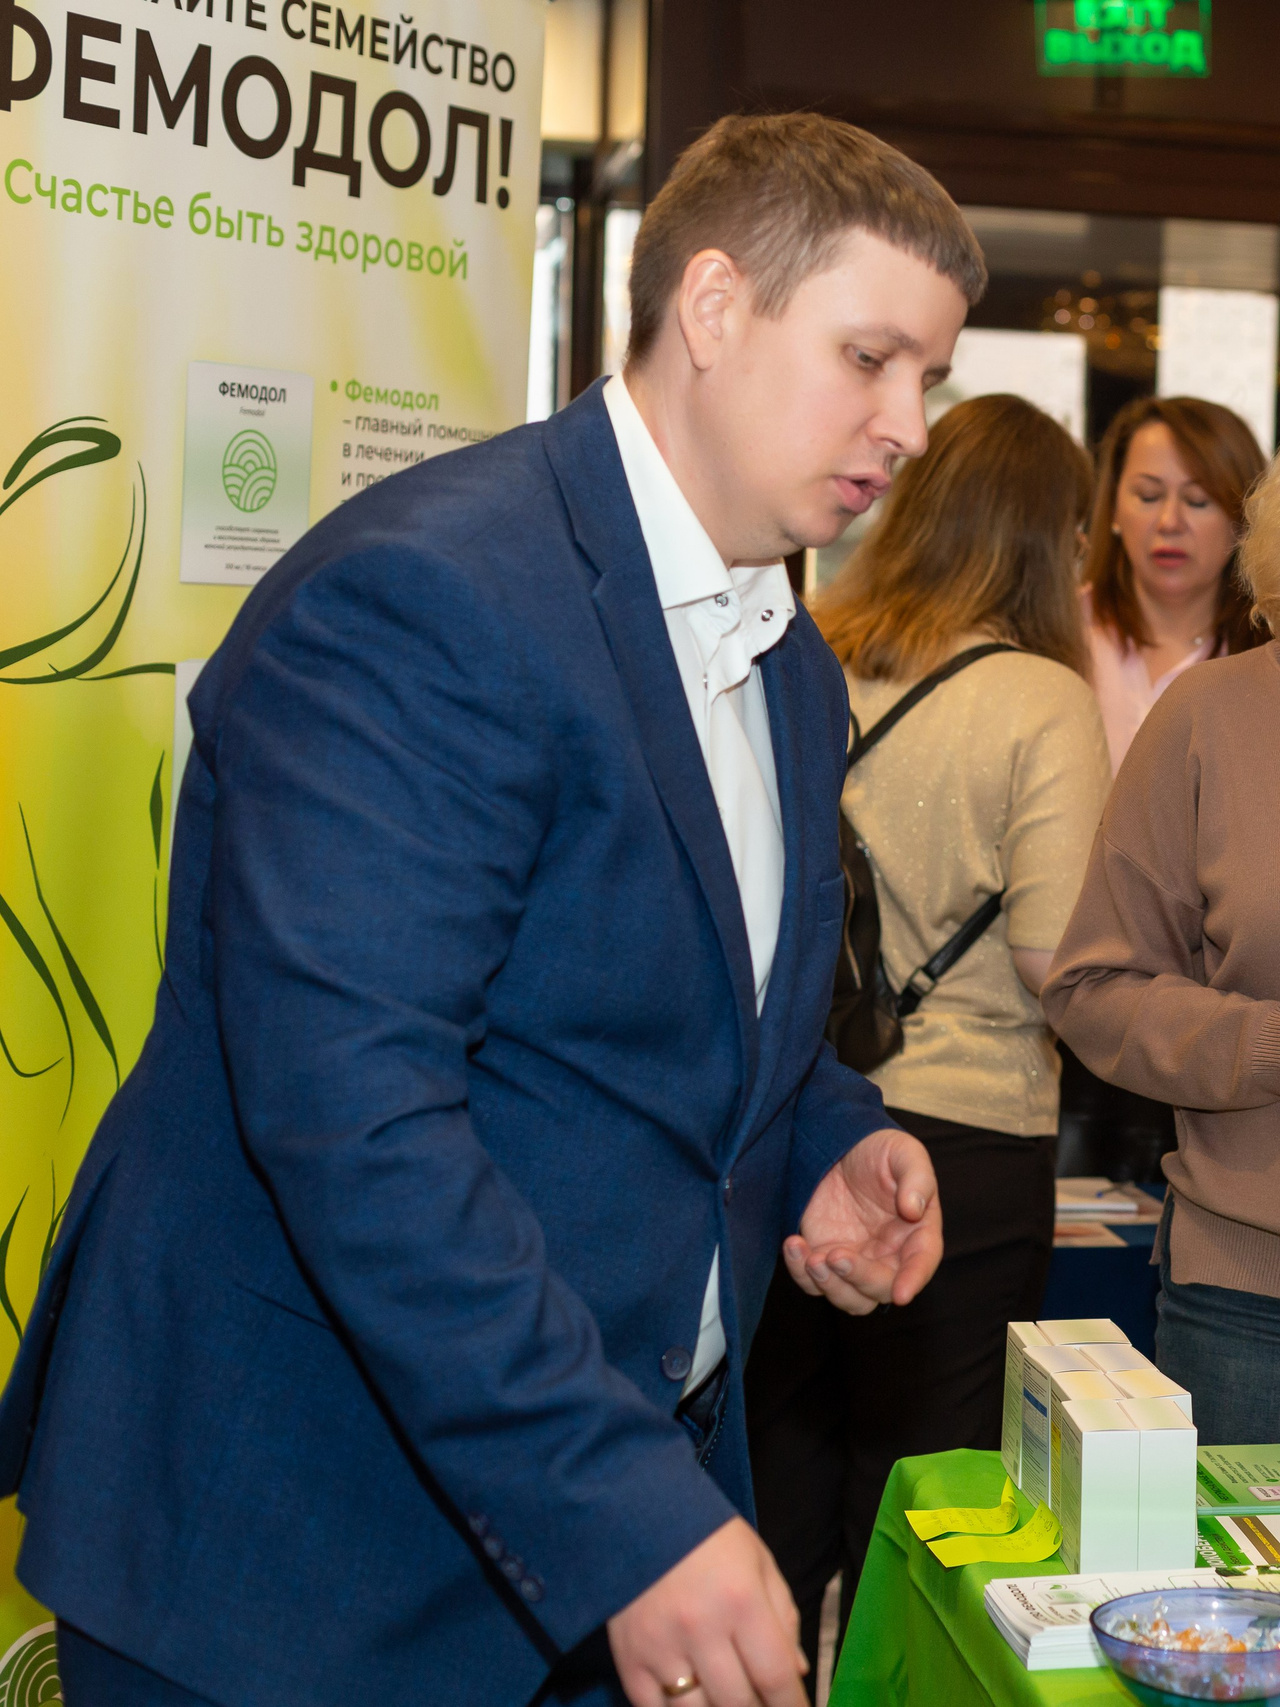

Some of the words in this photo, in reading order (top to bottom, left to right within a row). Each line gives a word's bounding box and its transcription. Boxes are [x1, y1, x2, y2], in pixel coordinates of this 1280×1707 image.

[281, 0, 516, 93] СЕМЕЙСТВО
[4, 158, 174, 229] Счастье
[188, 191, 285, 248] быть
[295, 220, 469, 281] здоровой
[218, 381, 287, 405] ФЕМОДОЛ
[345, 379, 440, 411] Фемодол
[355, 415, 423, 437] главный
[427, 423, 501, 443] помощн
[342, 443, 351, 458] в
[355, 444, 424, 463] лечении
[341, 471, 351, 486] и
